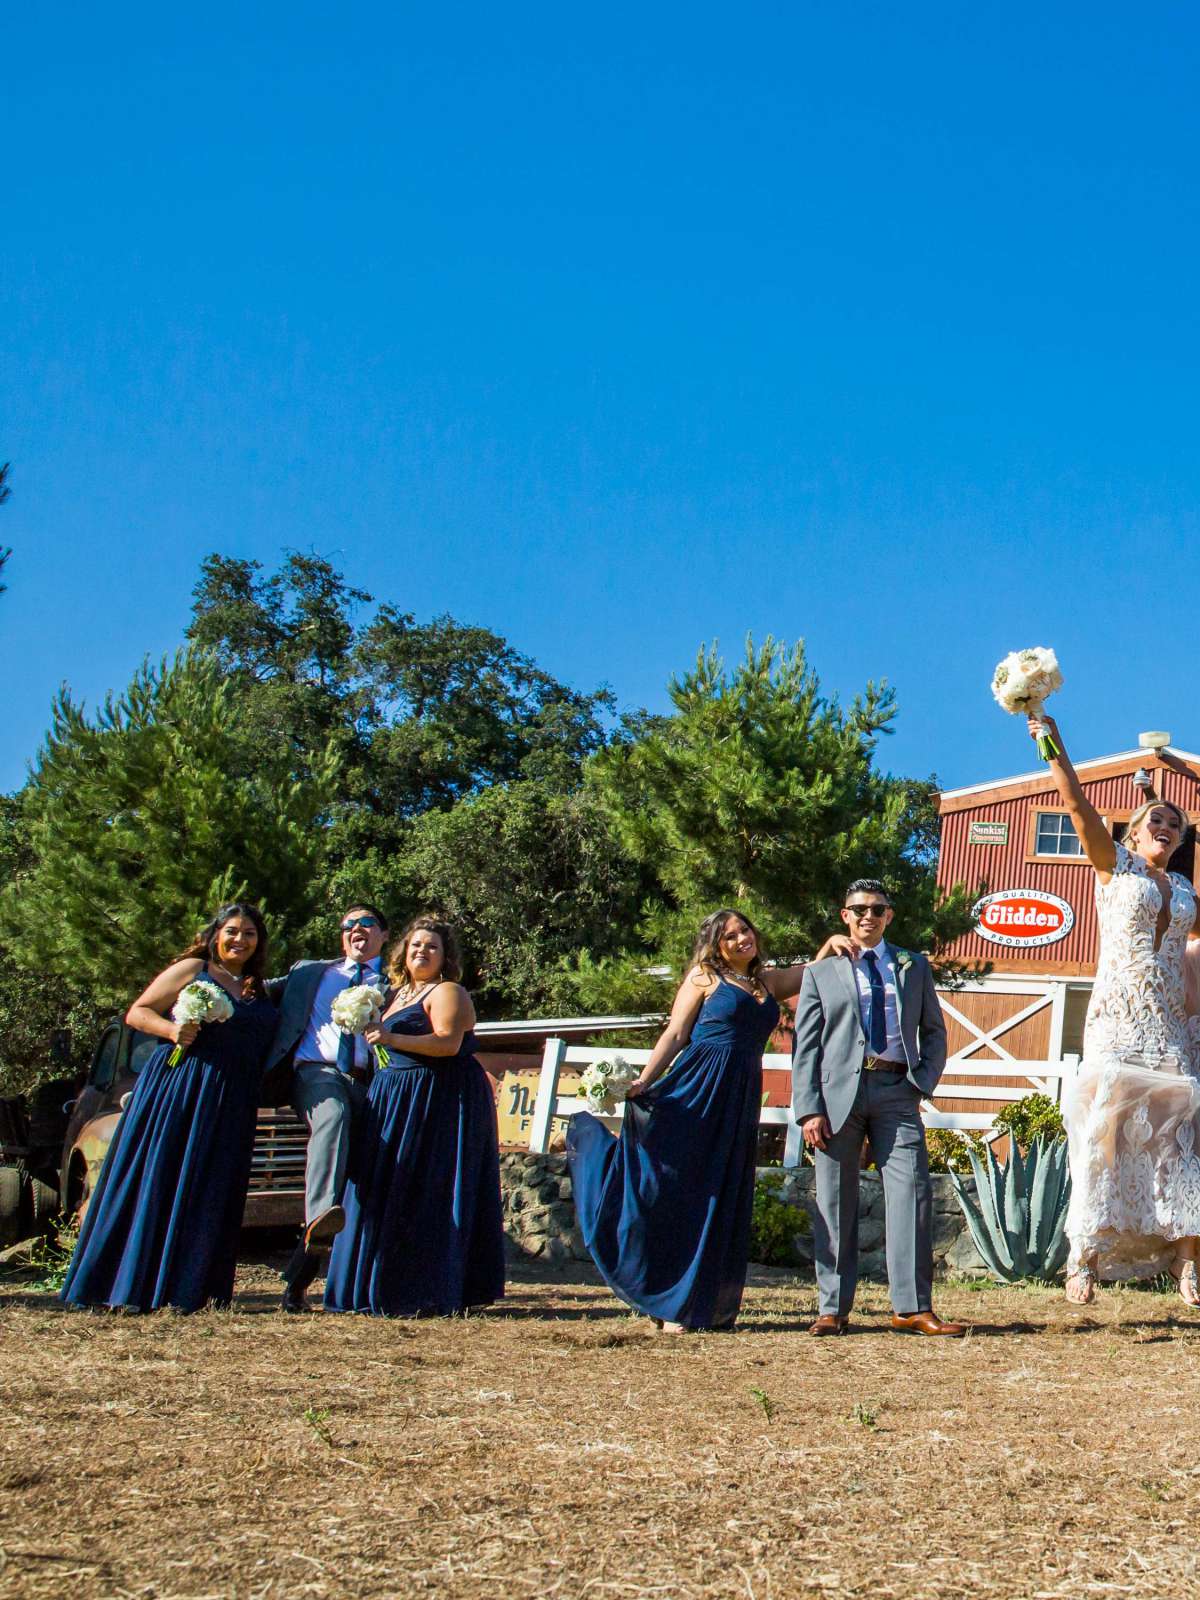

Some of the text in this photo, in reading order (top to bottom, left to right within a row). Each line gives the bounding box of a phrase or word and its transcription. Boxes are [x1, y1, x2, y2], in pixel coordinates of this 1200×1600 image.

[973, 825, 1005, 835] Sunkist
[1002, 892, 1050, 901] QUALITY
[985, 905, 1059, 927] Glidden
[991, 933, 1052, 946] PRODUCTS
